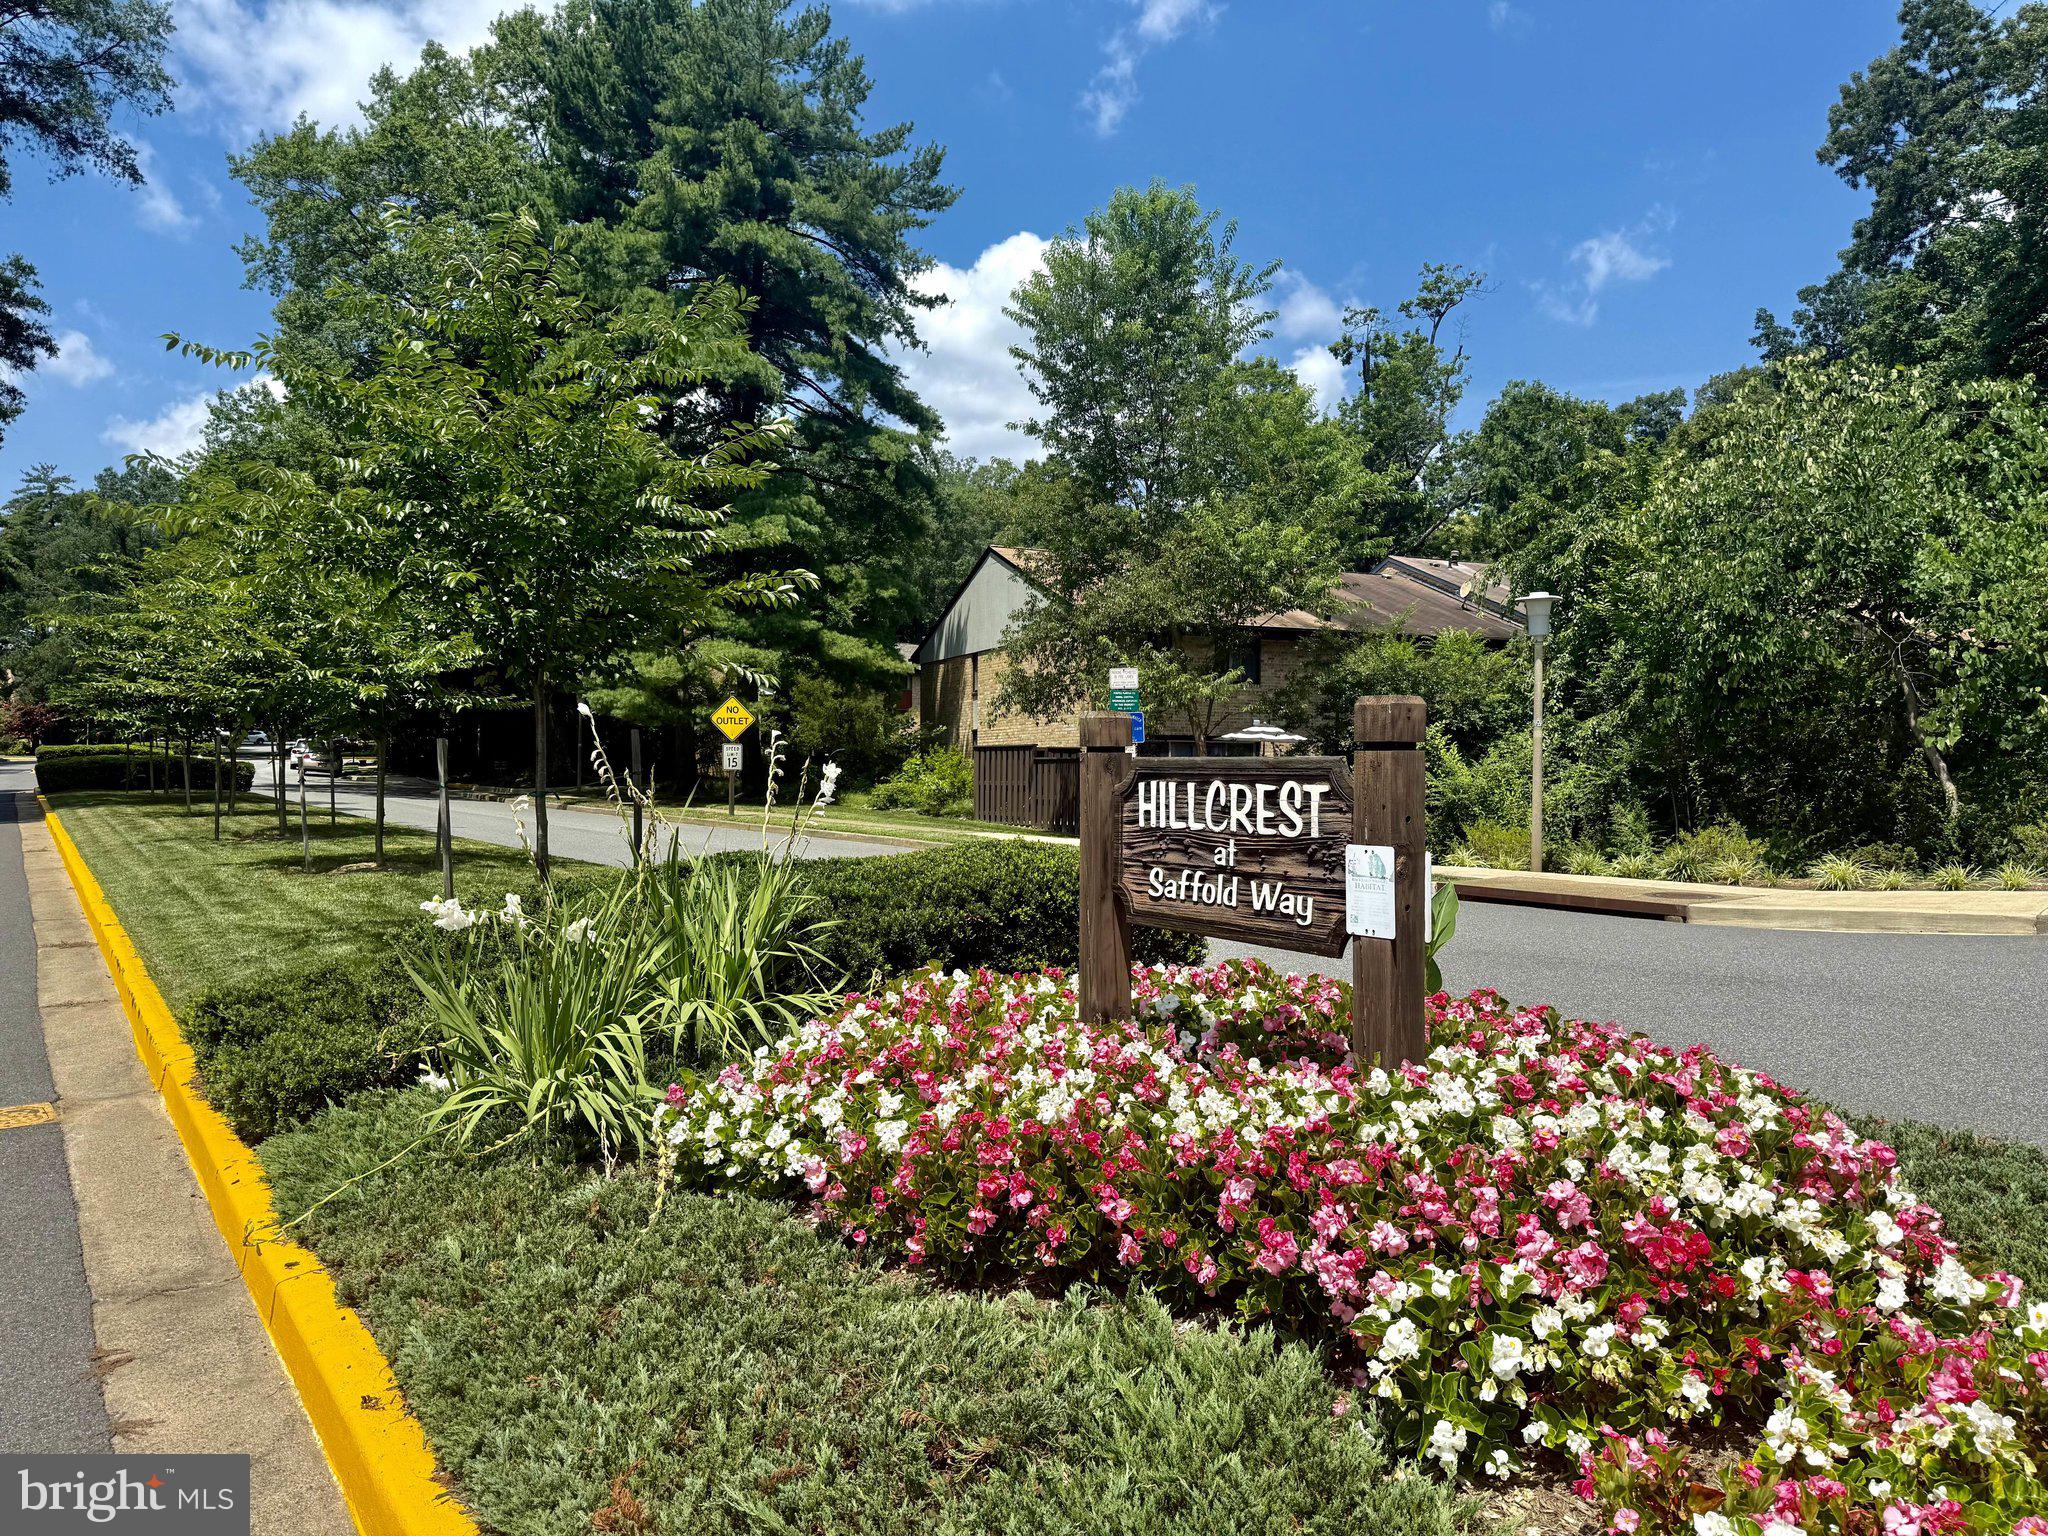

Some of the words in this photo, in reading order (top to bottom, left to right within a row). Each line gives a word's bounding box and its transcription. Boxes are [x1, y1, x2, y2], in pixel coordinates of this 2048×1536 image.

[726, 706, 739, 714] NO
[716, 717, 749, 725] OUTLET
[727, 758, 738, 768] 15
[1138, 780, 1330, 838] HILLCREST
[1213, 839, 1239, 867] at
[1354, 882, 1385, 891] HABITAT
[1148, 867, 1239, 907] Saffold
[1250, 880, 1314, 926] Way
